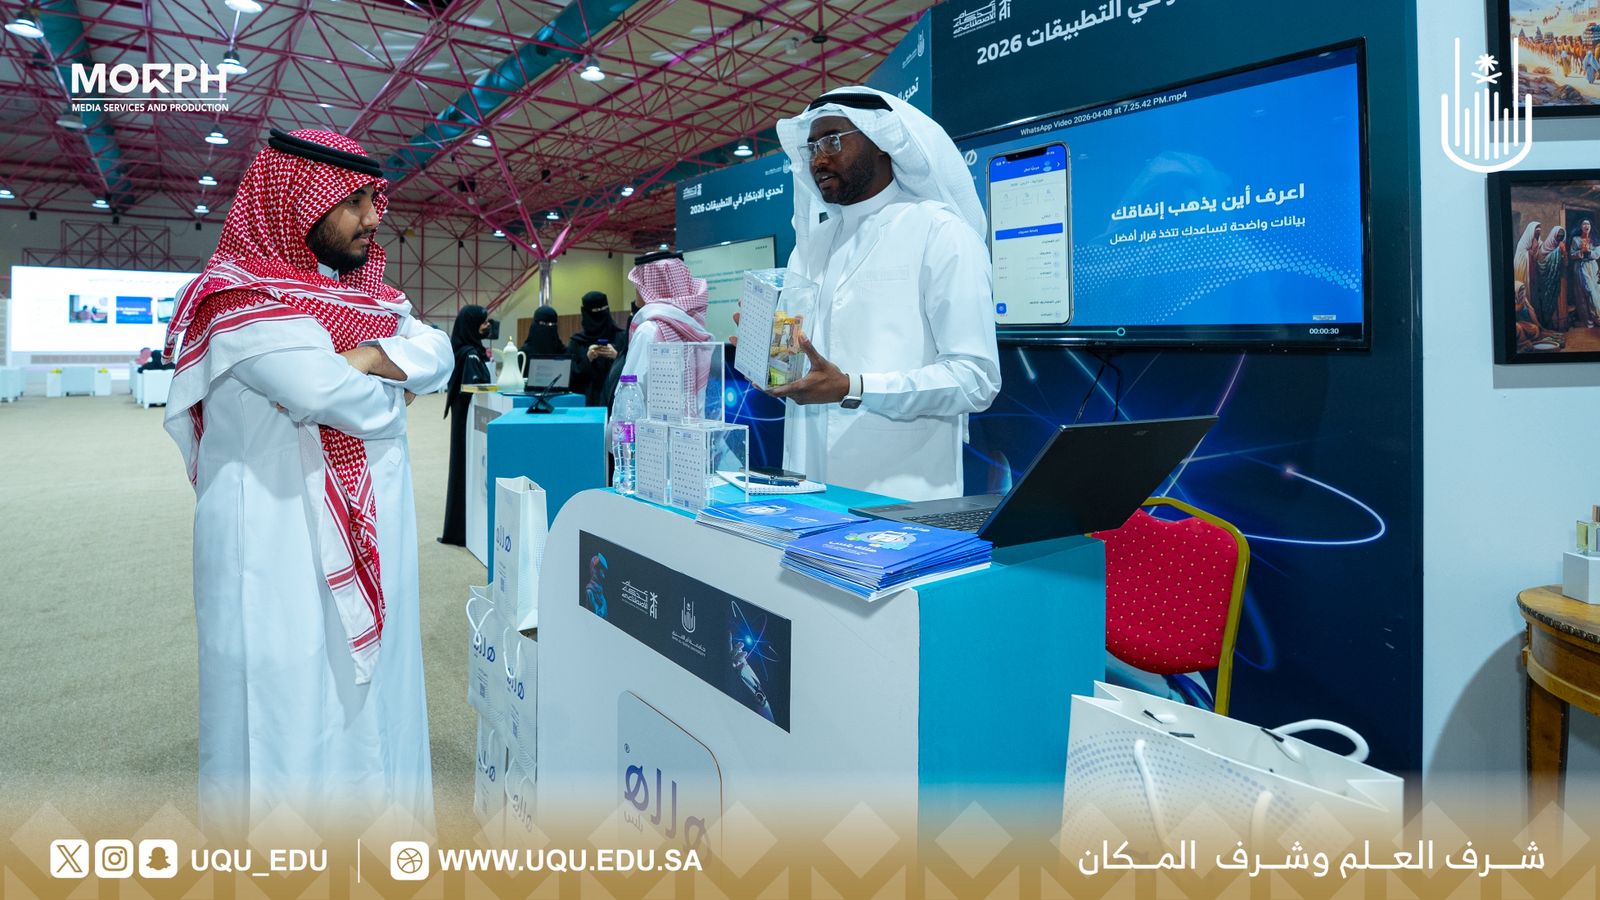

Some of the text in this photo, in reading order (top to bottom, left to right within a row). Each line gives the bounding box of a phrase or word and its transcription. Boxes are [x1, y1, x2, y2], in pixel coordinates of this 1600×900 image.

[1026, 0, 1121, 47] التطبيقات
[976, 34, 1022, 65] 2026
[1020, 90, 1188, 136] WhatsApp Video 2026-04-08 at 7.25.42 PM.mp4
[690, 184, 784, 215] تحدي الابتكار في التطبيقات 2026
[1111, 183, 1305, 221] اعرف أين يذهب إنفاقك
[1109, 215, 1306, 246] بيانات واضحة تساعدك تتخذ قرار أفضل
[1309, 327, 1340, 335] 00:00:30
